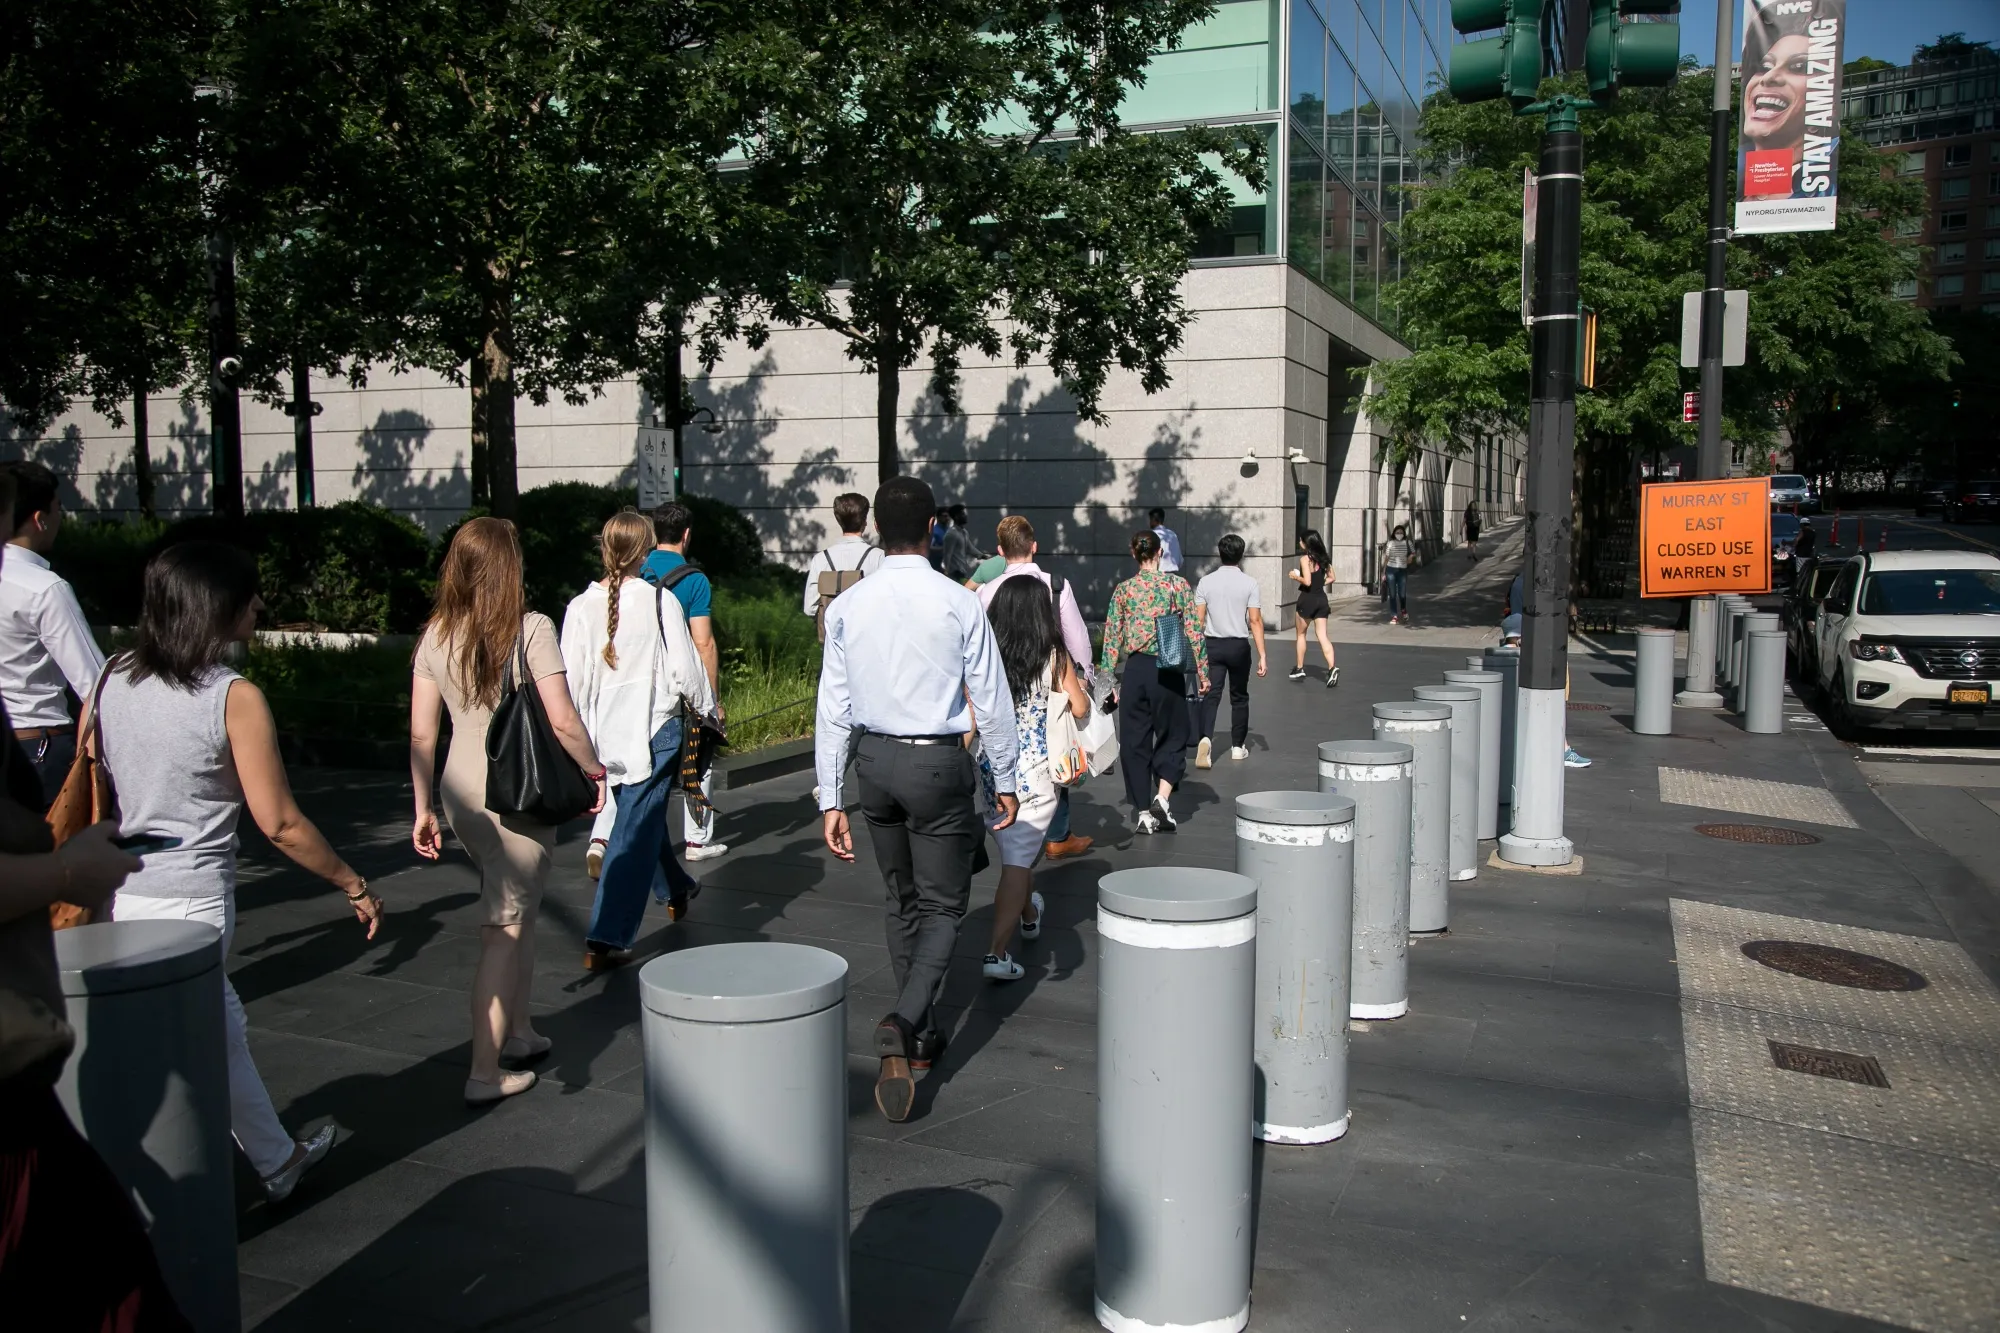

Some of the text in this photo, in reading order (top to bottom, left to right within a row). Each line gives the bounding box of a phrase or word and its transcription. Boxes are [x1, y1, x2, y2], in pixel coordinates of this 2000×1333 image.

[1776, 1, 1812, 15] NYC
[1801, 18, 1838, 192] STAY AMAZING
[1745, 206, 1825, 216] NYP.ORG/STAYAMAZING
[1662, 492, 1750, 508] MURRAY ST
[1685, 517, 1725, 531] EAST
[1657, 541, 1754, 557] CLOSED USE
[1661, 565, 1751, 580] WARREN ST
